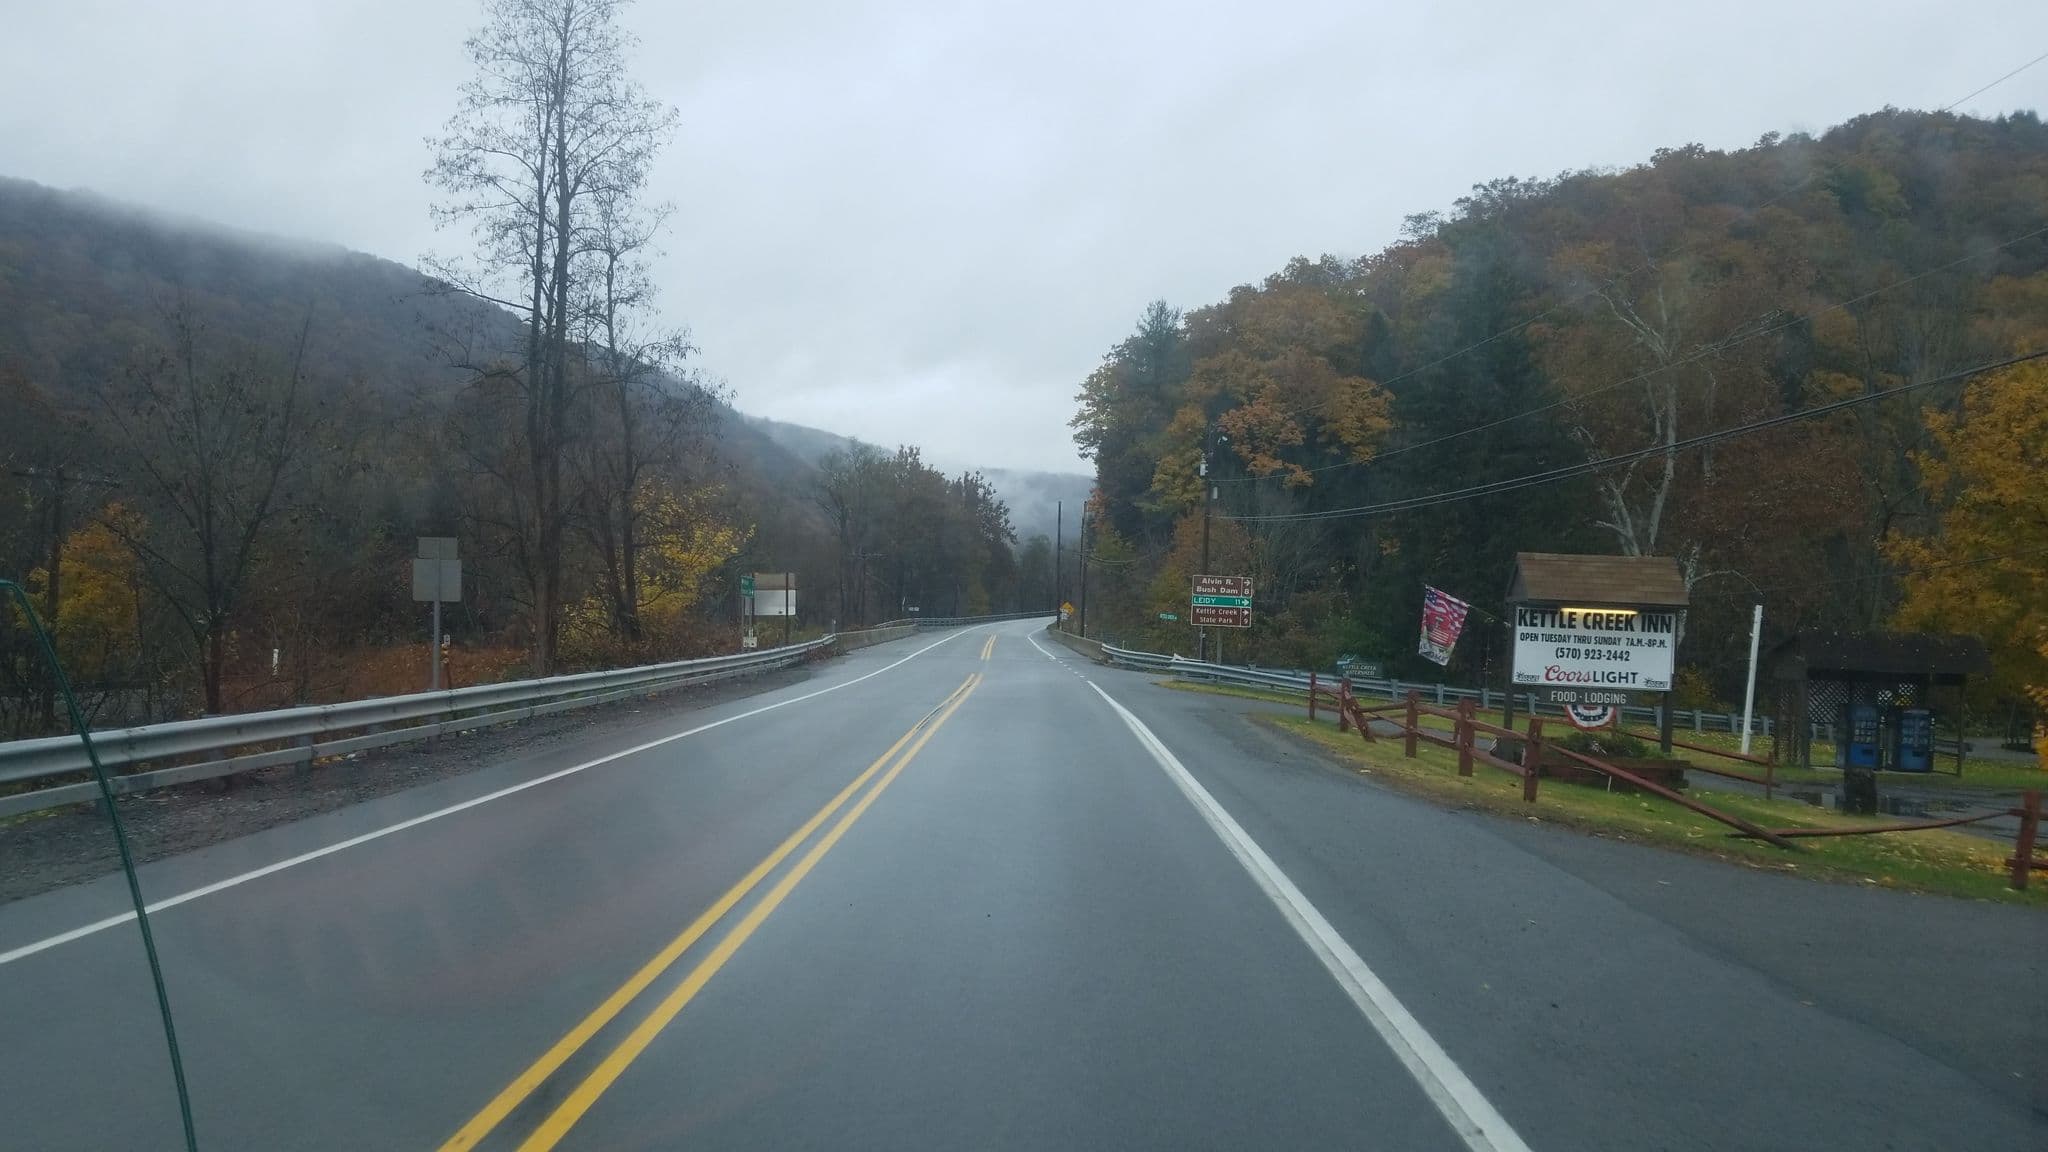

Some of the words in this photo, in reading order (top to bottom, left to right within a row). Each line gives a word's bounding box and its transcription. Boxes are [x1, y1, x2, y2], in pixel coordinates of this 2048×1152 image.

[1201, 577, 1222, 585] Alvin
[1193, 596, 1216, 604] LEIDY
[1517, 608, 1577, 630] KETTLE
[1582, 611, 1637, 633] CREEK
[1641, 616, 1673, 635] INN
[1519, 632, 1539, 642] OPEN
[1541, 633, 1571, 645] TUESDAY
[1573, 634, 1593, 645] THRU
[1594, 636, 1622, 647] SUNDAY
[1555, 647, 1581, 661] (570)
[1584, 649, 1631, 662] 923-2442
[1544, 664, 1591, 684] Coors
[1592, 670, 1639, 685] LIGHT
[1551, 690, 1577, 702] FOOD
[1584, 692, 1628, 704] LODGING
